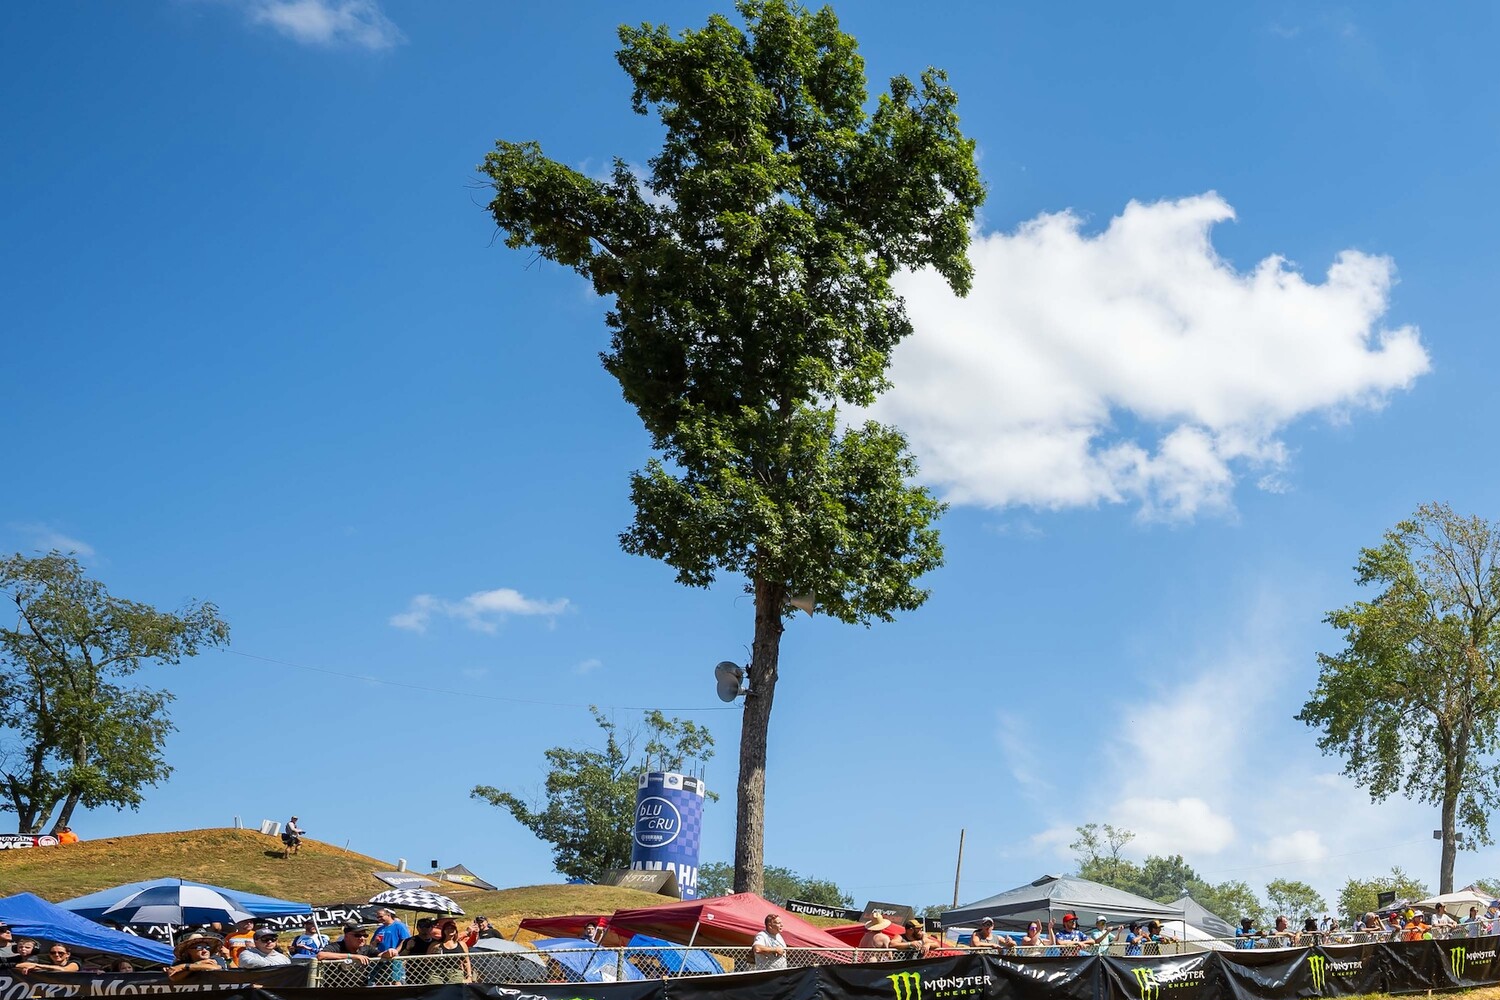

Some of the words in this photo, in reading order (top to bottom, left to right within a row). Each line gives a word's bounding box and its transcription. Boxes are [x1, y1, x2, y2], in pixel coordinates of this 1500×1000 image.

[790, 903, 834, 918] TRIUMPH
[1466, 950, 1496, 960] MONSTER
[1326, 961, 1362, 972] MONSTER
[924, 975, 992, 991] MONSTER
[936, 988, 984, 998] ENERGY
